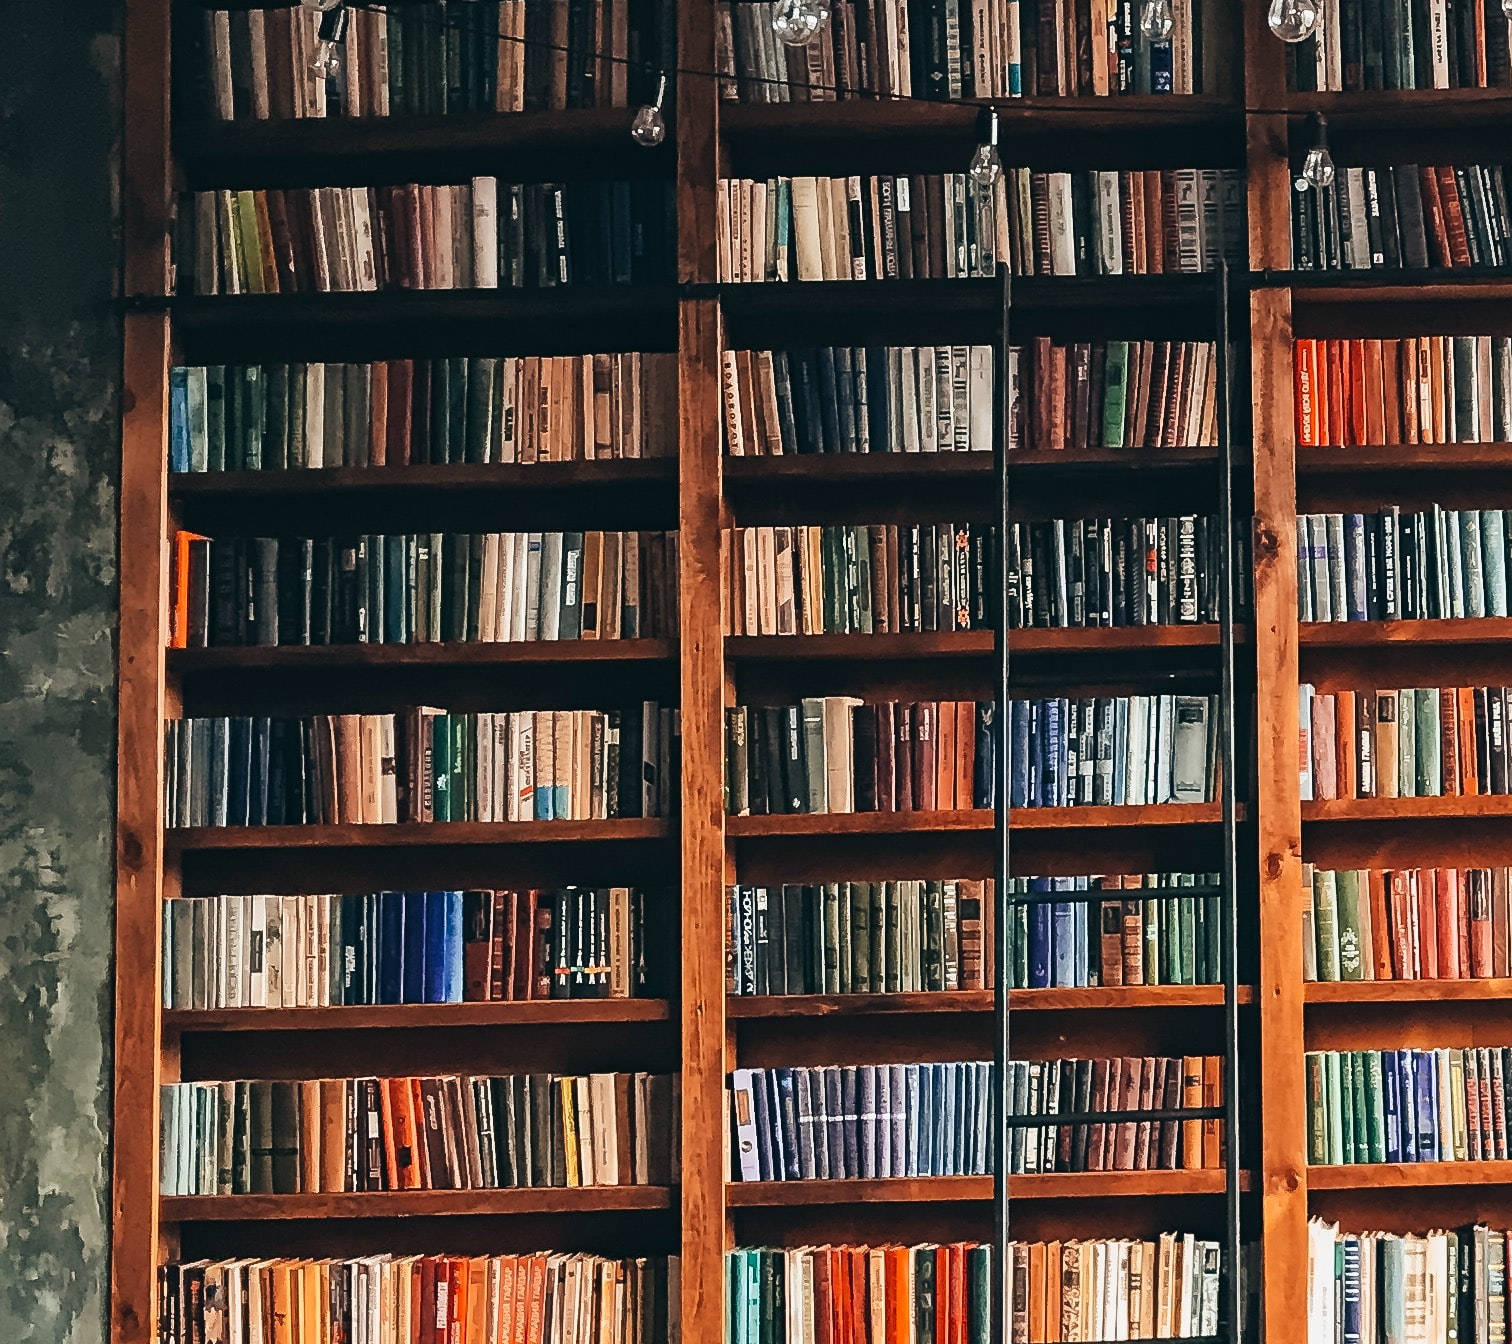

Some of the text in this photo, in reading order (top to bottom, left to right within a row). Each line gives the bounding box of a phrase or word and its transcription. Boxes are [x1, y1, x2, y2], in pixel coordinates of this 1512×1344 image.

[503, 1266, 512, 1301] ГАЙДАР
[517, 1264, 526, 1299] ГАЙДАР
[532, 1264, 541, 1299] ГАЙДАР
[515, 1301, 525, 1344] АРКАДИЙ
[530, 1301, 540, 1344] АРКАДИЙ
